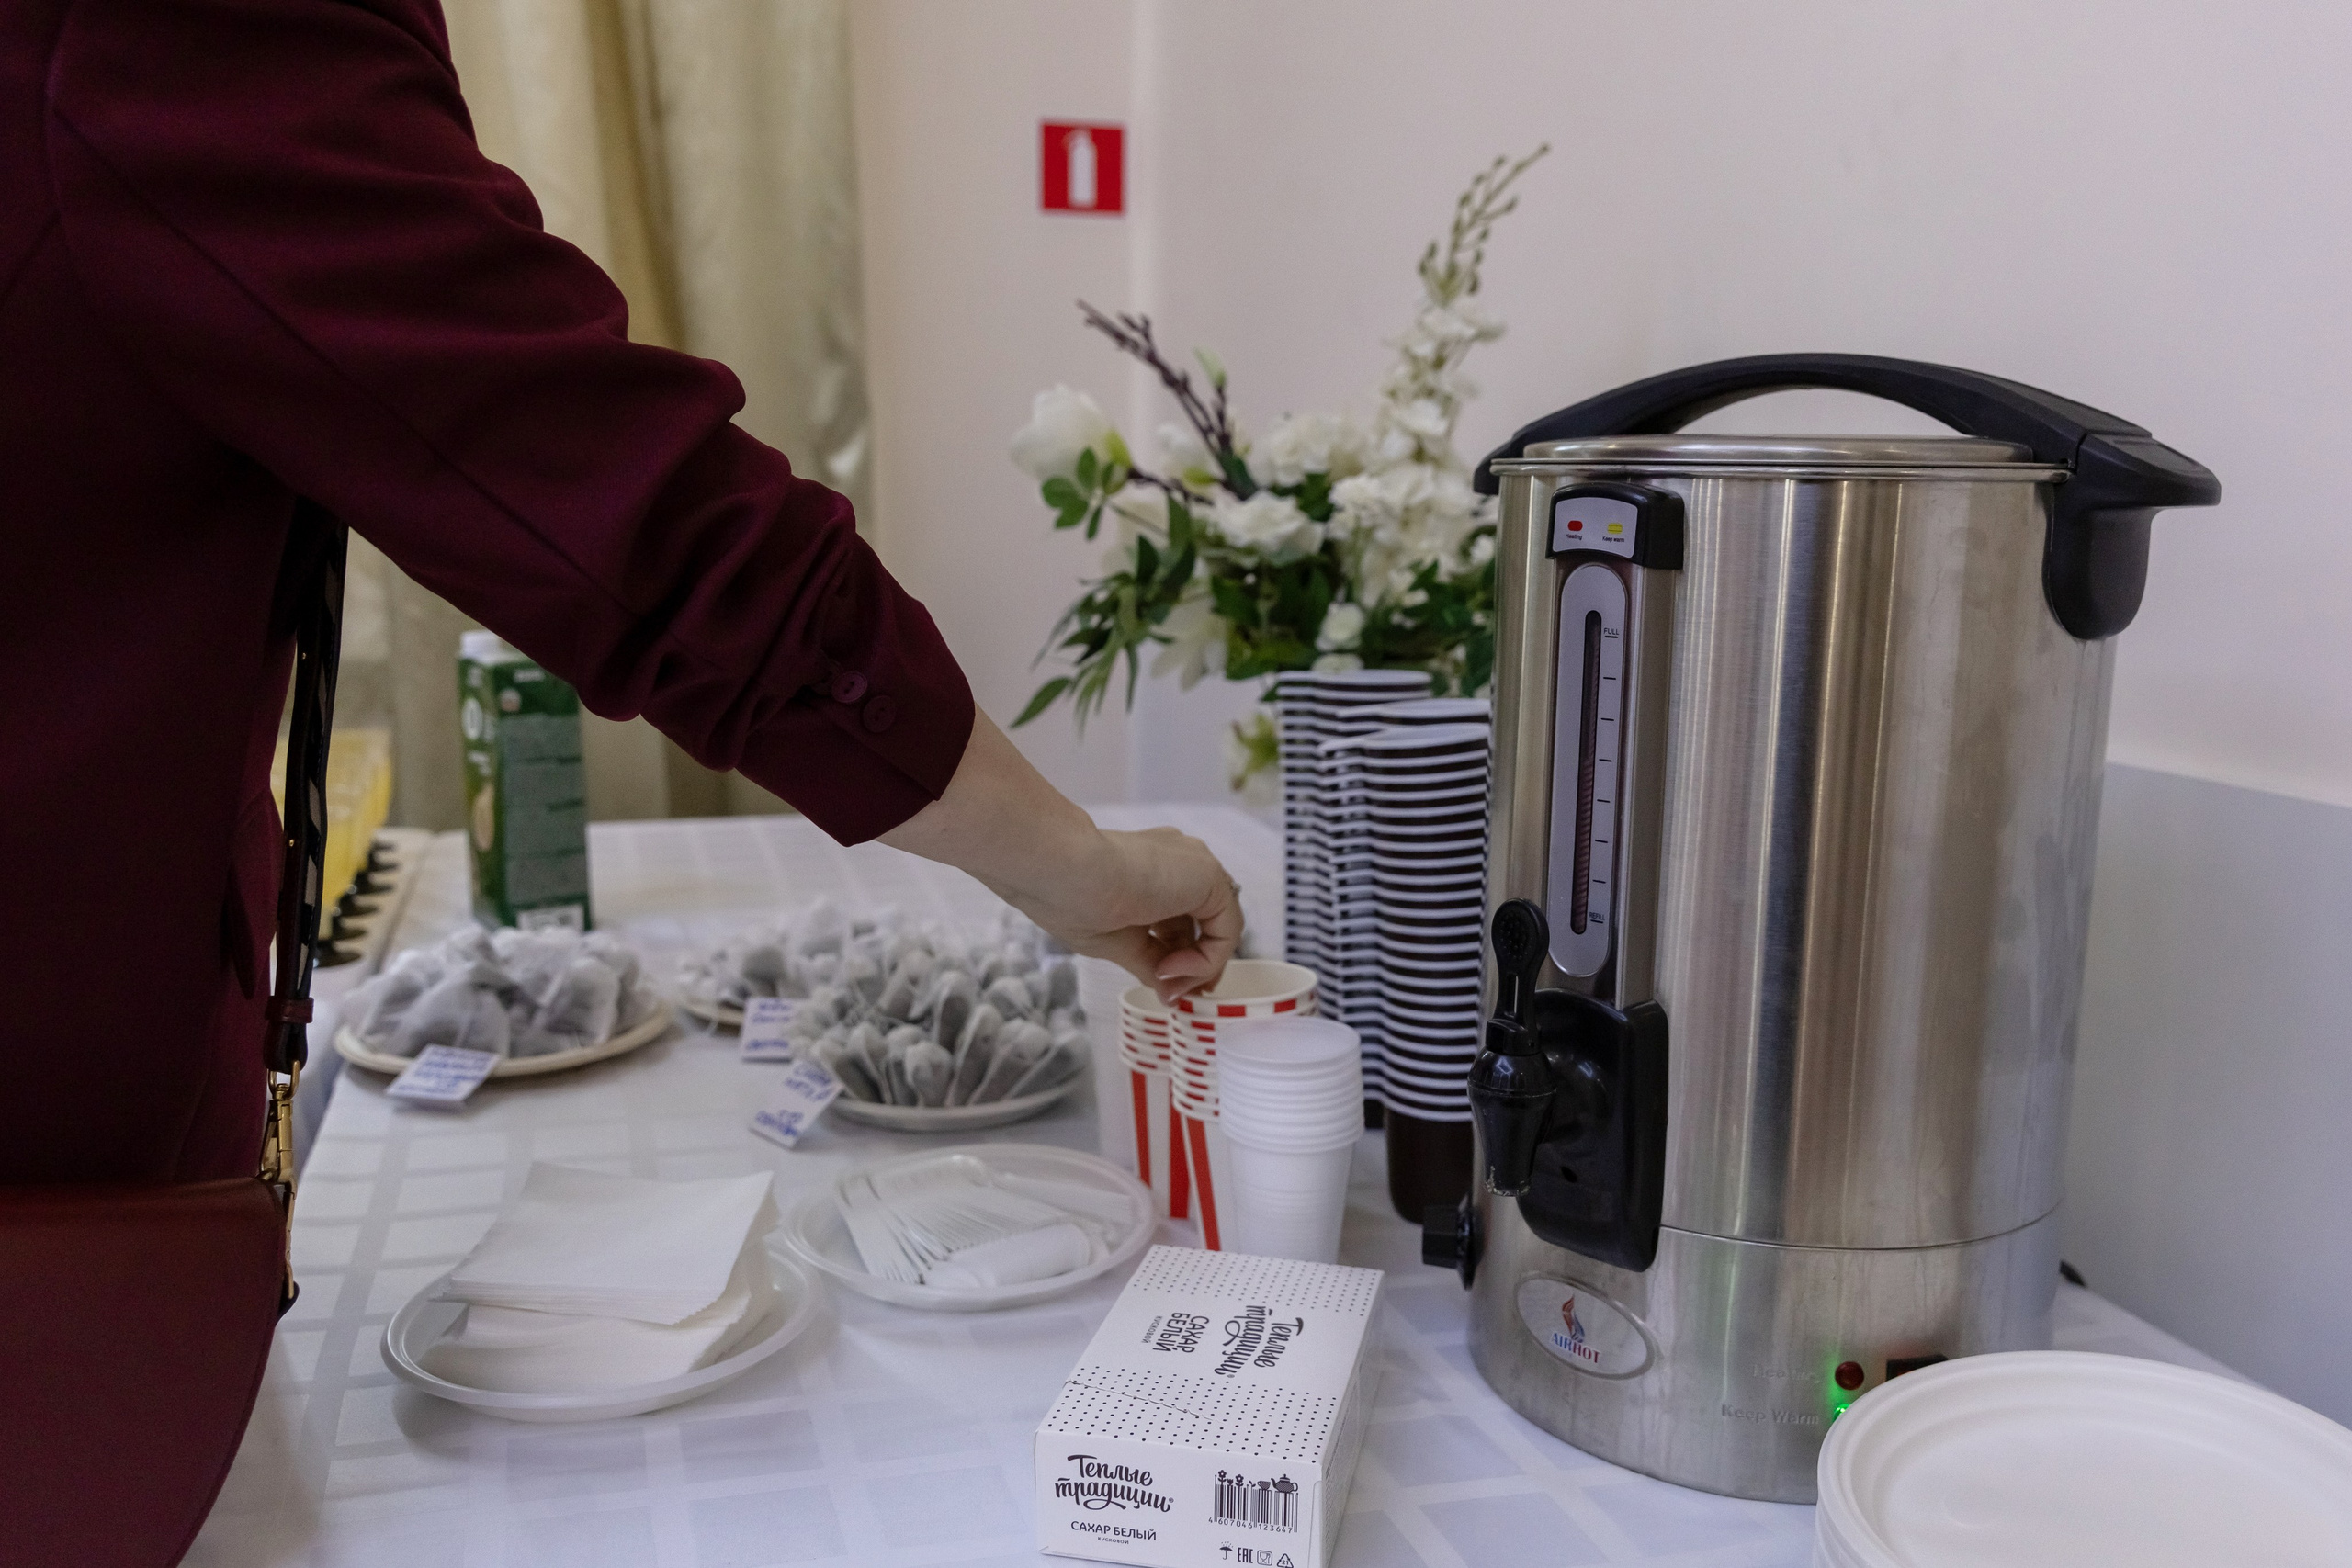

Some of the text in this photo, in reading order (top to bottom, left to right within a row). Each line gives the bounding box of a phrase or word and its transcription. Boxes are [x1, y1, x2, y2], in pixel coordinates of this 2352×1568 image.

[1152, 1312, 1191, 1353] БЕЛЫЙ
[1176, 1315, 1210, 1353] САХАР
[1253, 1317, 1304, 1368] Теплые
[1552, 1332, 1600, 1363] AIRHOT
[1721, 1404, 1820, 1425] Keep Warm
[1067, 1454, 1153, 1486] Теплые
[1070, 1520, 1157, 1541] САХАР БЕЛЫЙ
